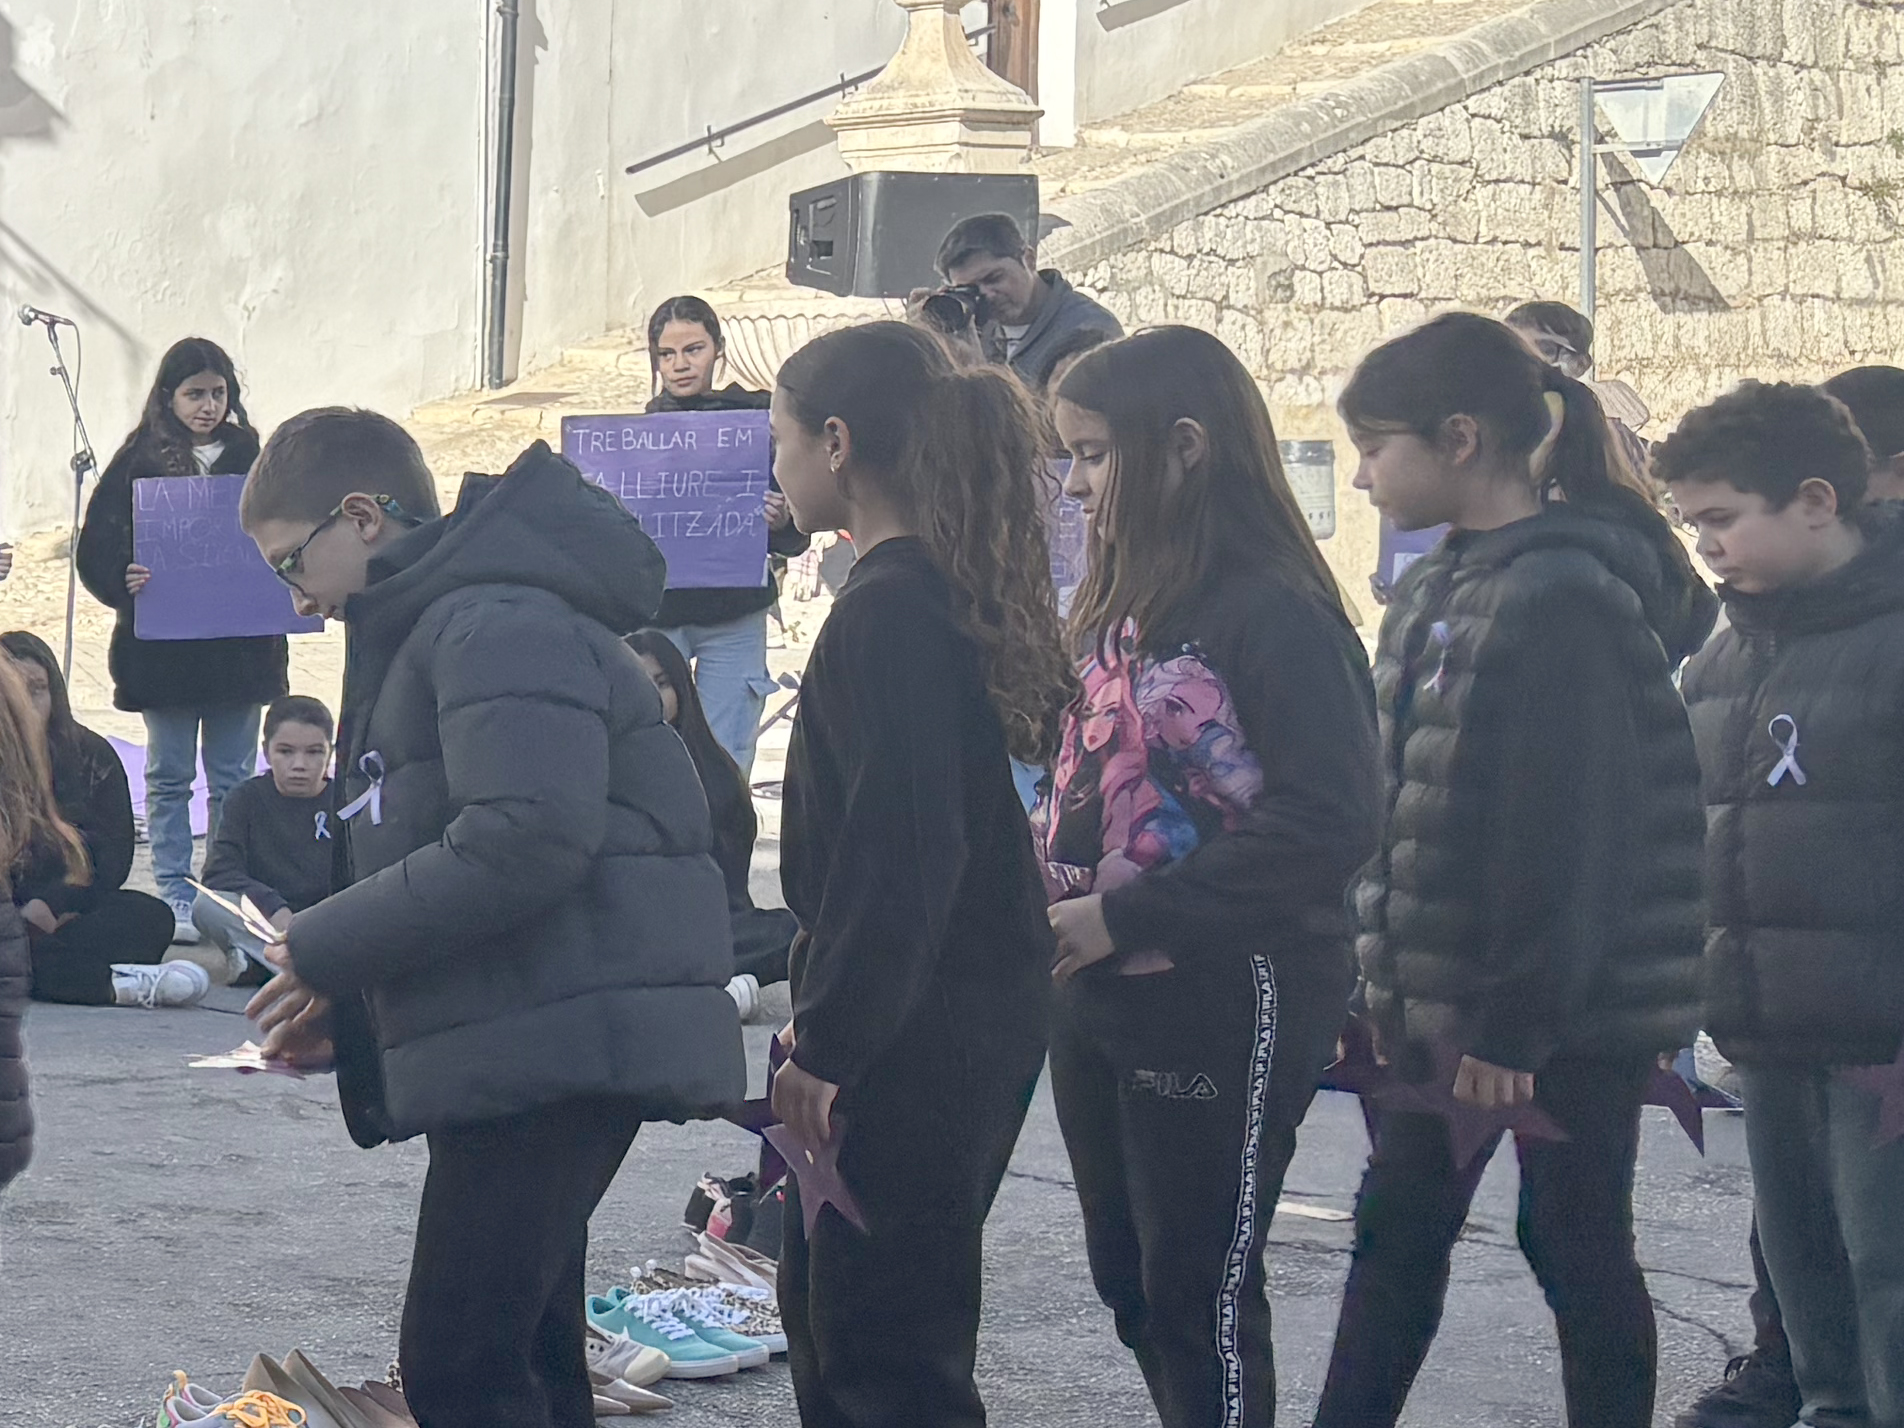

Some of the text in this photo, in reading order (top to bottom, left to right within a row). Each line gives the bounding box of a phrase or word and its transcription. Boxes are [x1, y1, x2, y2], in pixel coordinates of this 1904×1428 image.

[717, 427, 752, 447] EM
[138, 480, 174, 512] LA
[620, 471, 724, 499] LLIURE
